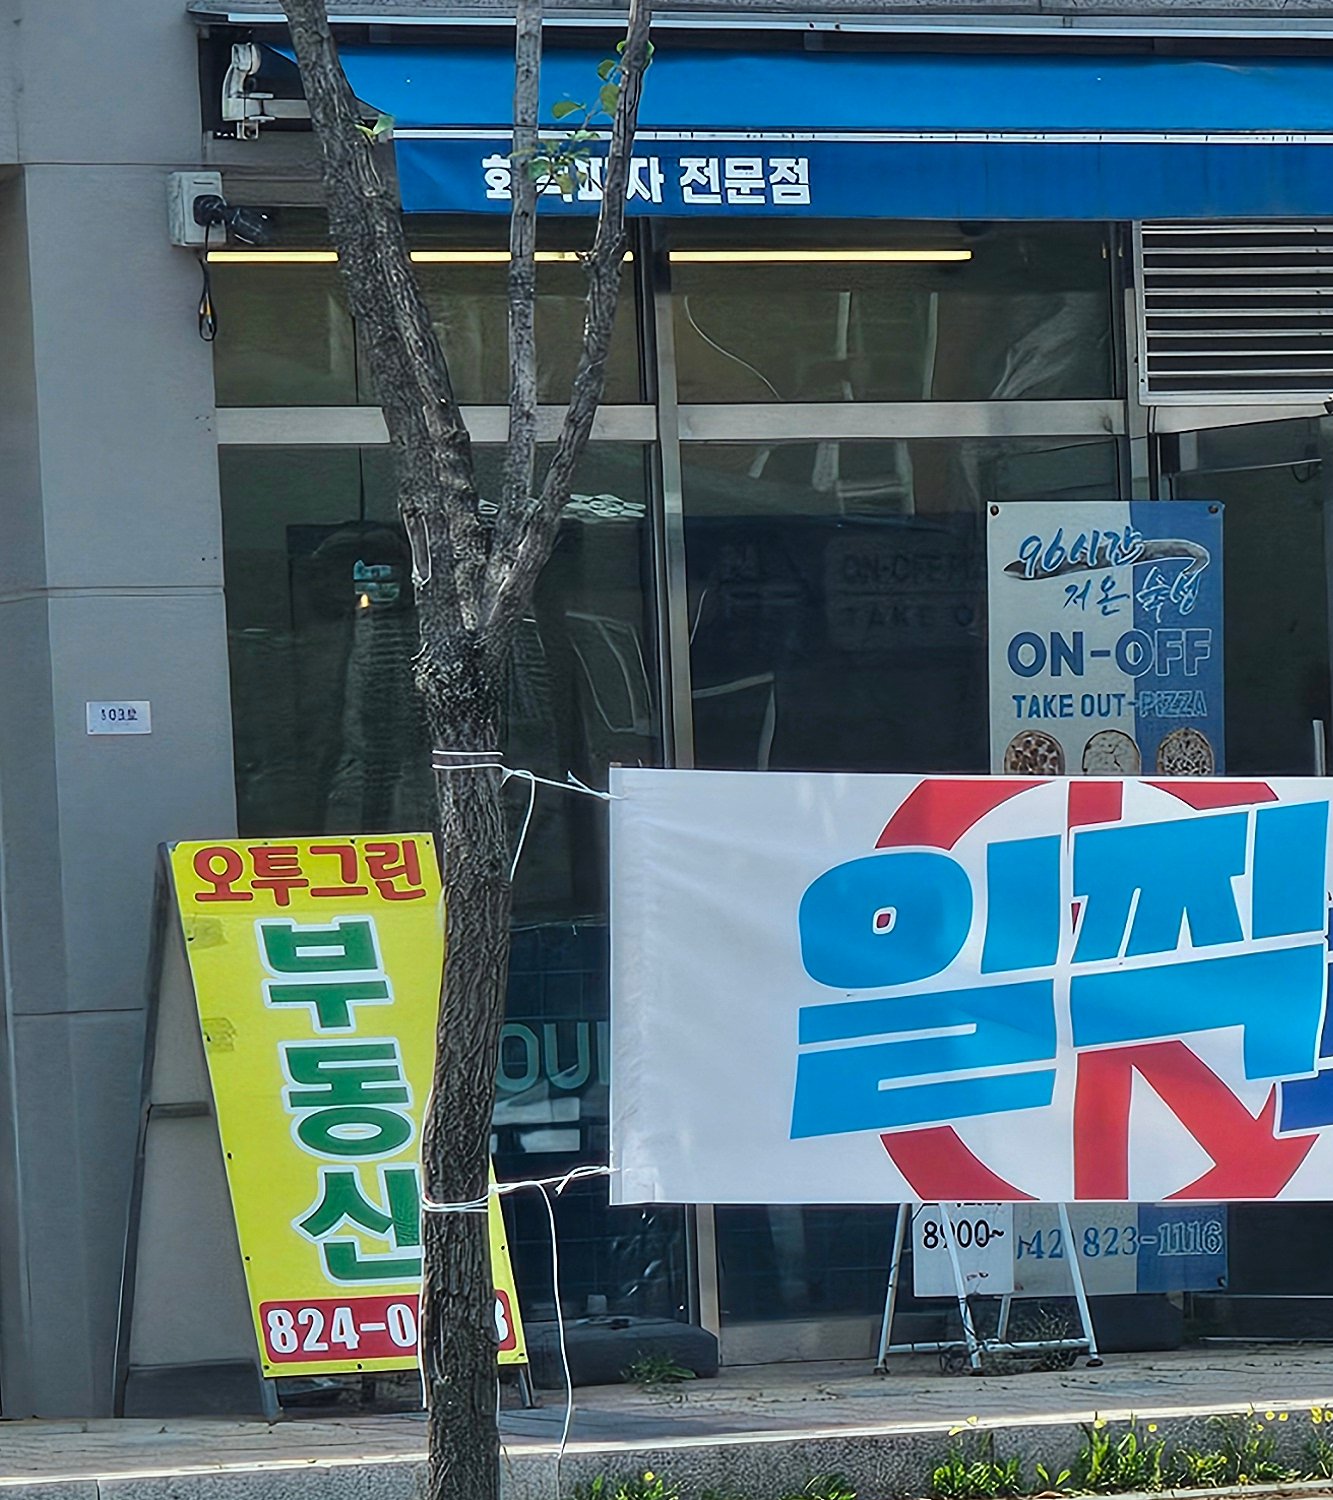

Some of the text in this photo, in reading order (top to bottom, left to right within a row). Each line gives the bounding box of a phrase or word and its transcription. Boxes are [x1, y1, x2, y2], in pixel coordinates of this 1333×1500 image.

[680, 157, 811, 205] 전문점
[1007, 628, 1212, 678] ON-OFF
[1012, 692, 1073, 719] TAKE
[192, 838, 427, 907] 오투그린
[789, 800, 1330, 1141] 일찍
